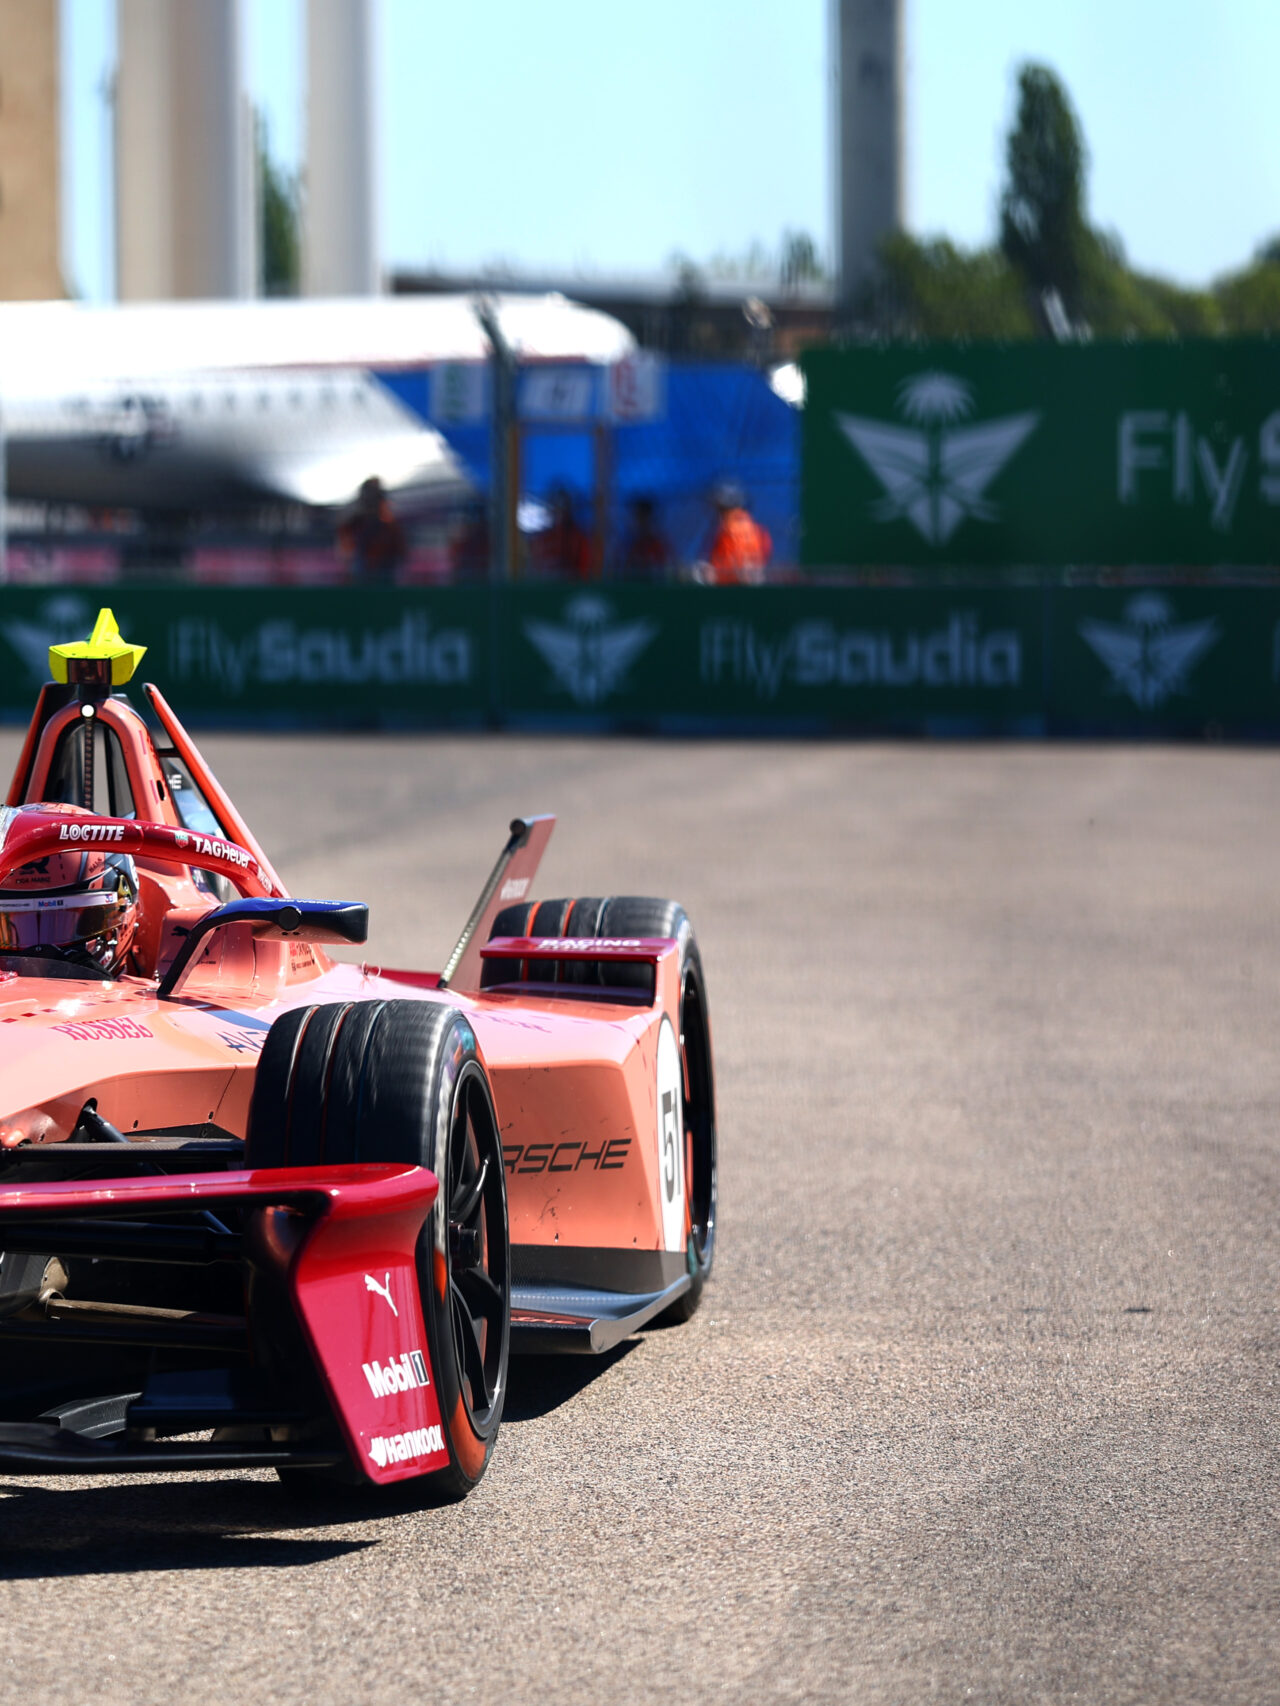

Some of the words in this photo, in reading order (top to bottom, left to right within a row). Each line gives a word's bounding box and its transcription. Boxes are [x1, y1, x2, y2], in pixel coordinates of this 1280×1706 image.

[169, 609, 474, 697] FlySaudia
[699, 609, 1022, 701] FlySaudia
[59, 824, 125, 841] LOCTITE
[38, 900, 57, 908] Mobil
[540, 939, 641, 947] RACING
[502, 1138, 632, 1174] RSCHE
[362, 1352, 417, 1399] Mobil
